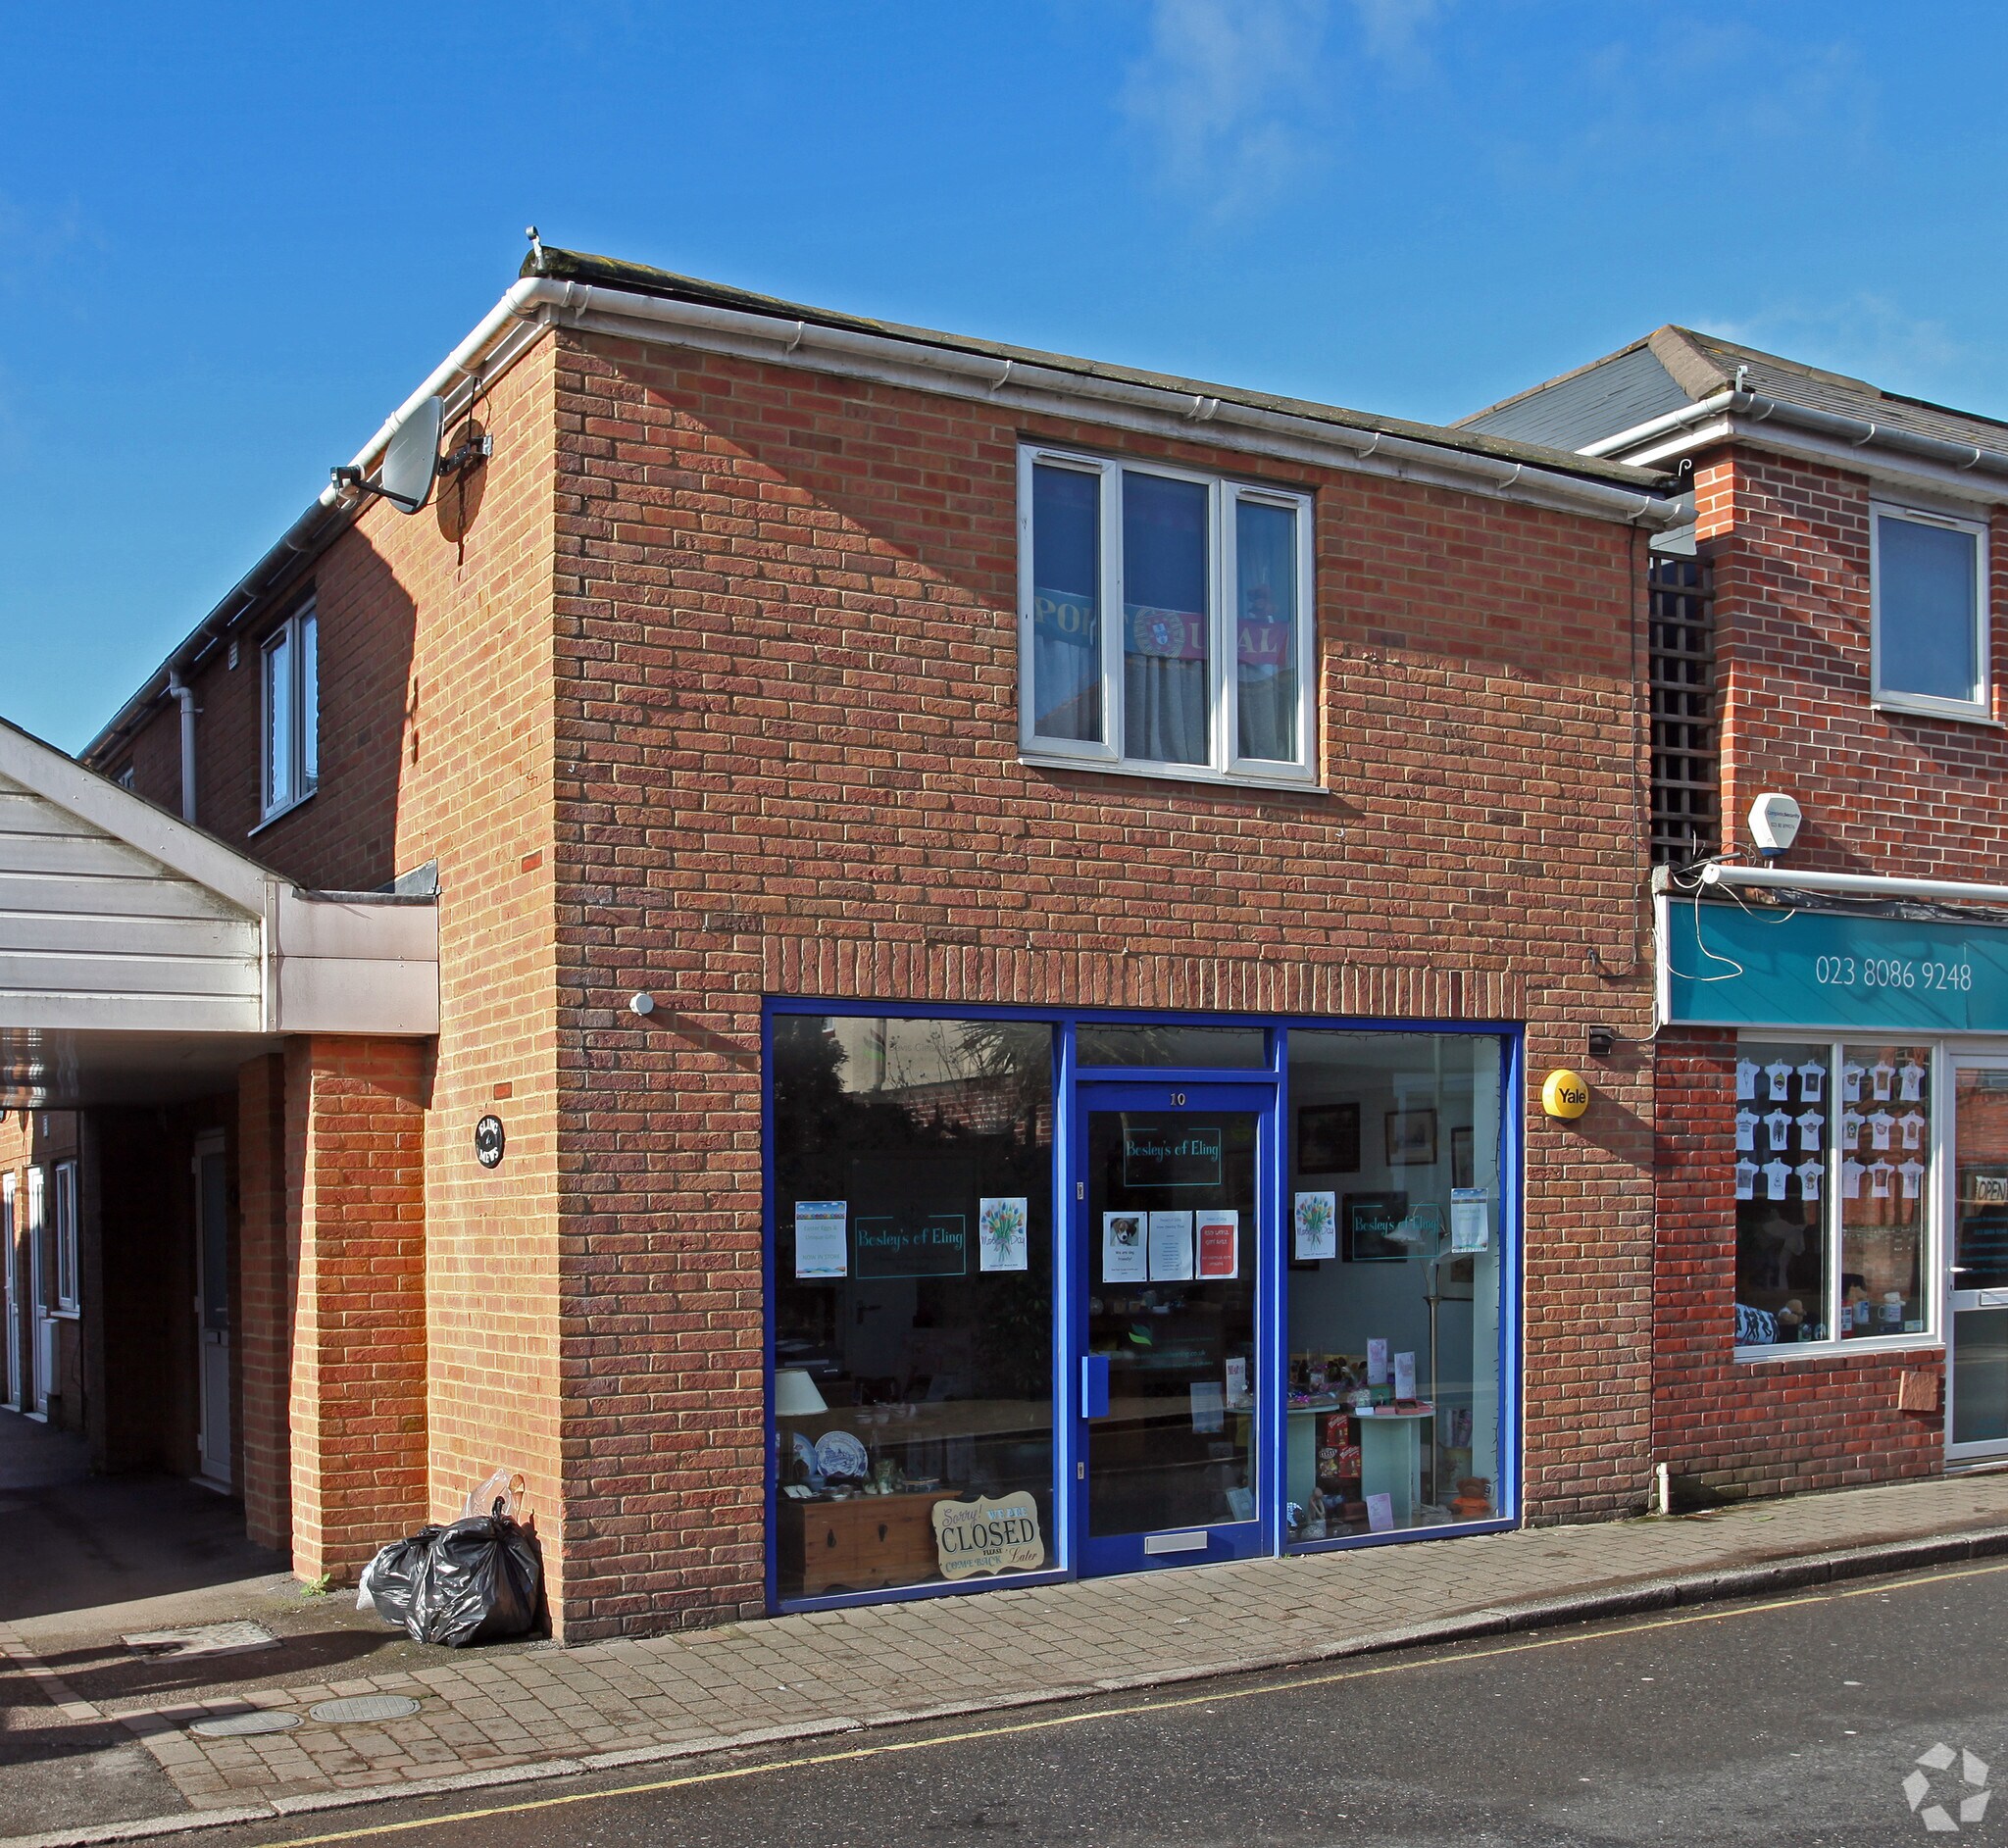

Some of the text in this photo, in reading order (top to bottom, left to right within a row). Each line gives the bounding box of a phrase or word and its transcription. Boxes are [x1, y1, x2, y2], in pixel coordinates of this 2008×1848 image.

[1816, 956, 1972, 991] 023 8086 9248
[1170, 1092, 1186, 1106] 10
[1558, 1088, 1586, 1104] Yale
[478, 1118, 499, 1137] ELING
[479, 1146, 499, 1164] MEWS
[1127, 1138, 1219, 1163] Bosley's of Eling
[1978, 1179, 2006, 1201] OPEN
[1355, 1216, 1394, 1235] Bosley's
[858, 1227, 963, 1253] Bosley's of Eling
[1011, 1234, 1026, 1247] Day
[942, 1504, 1028, 1528] Sorry! WE ARE
[941, 1518, 1034, 1553] CLOSED
[945, 1547, 1037, 1573] COME BACK Later
